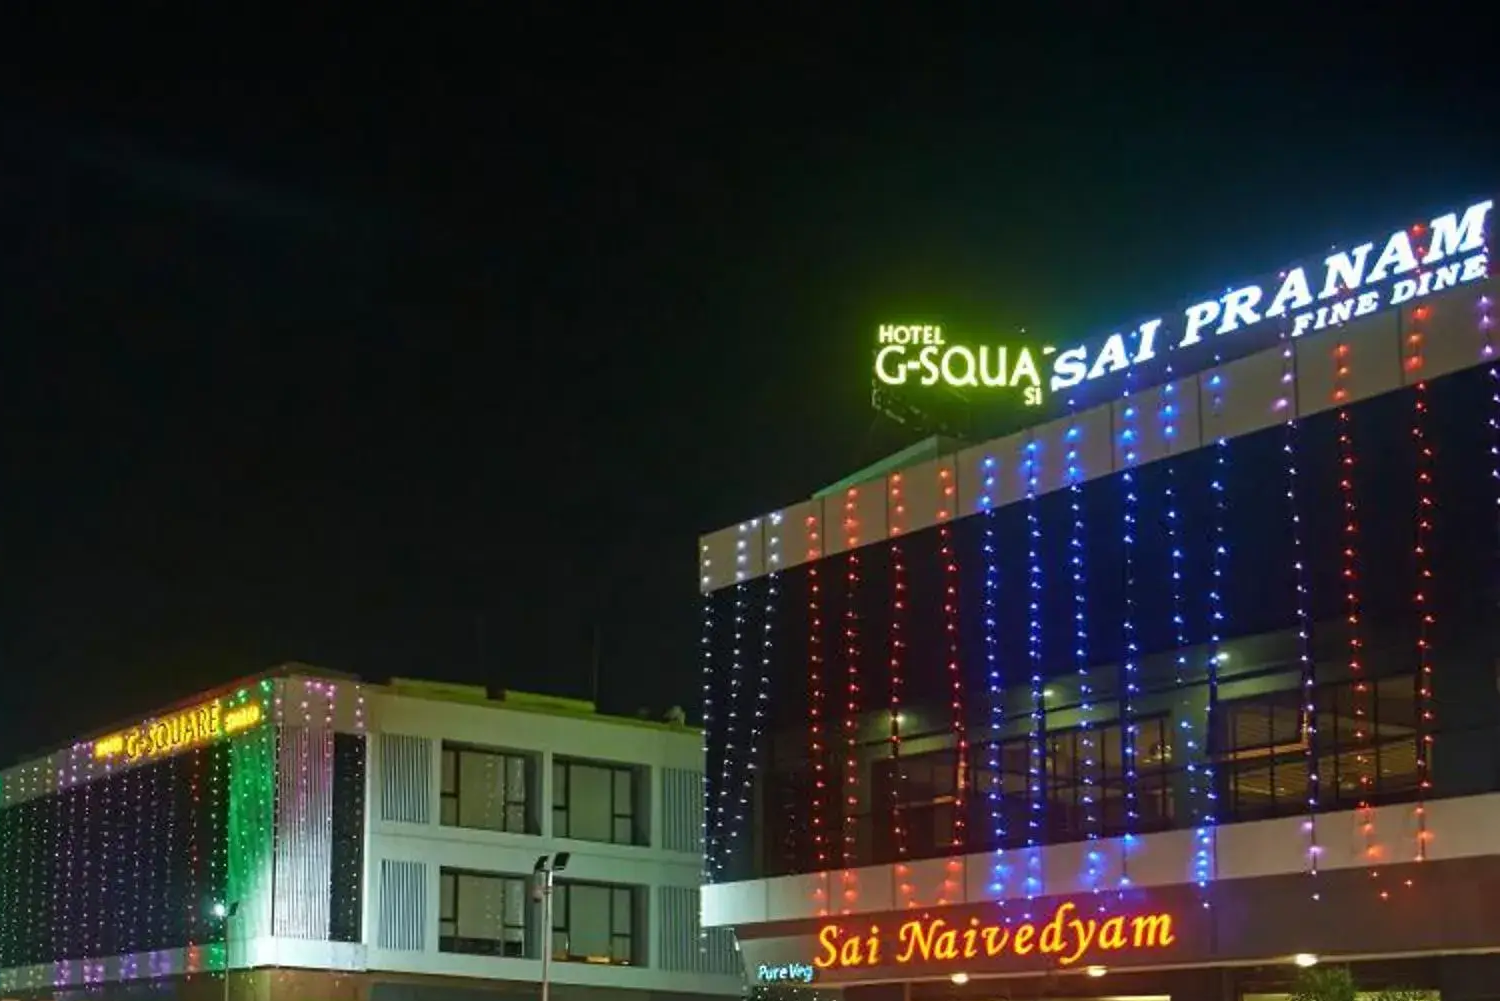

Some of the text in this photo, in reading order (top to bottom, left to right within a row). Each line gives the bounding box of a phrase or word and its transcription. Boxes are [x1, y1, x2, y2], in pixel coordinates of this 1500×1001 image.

[1051, 200, 1492, 391] SAI PRANAM
[1292, 254, 1489, 336] FINE DINE
[876, 345, 1056, 387] G-SQUA
[879, 325, 945, 345] HOTEL
[127, 699, 222, 763] G-SQUARE
[813, 902, 1175, 968] Sai Naivedyam
[758, 963, 813, 983] Pure Veg
